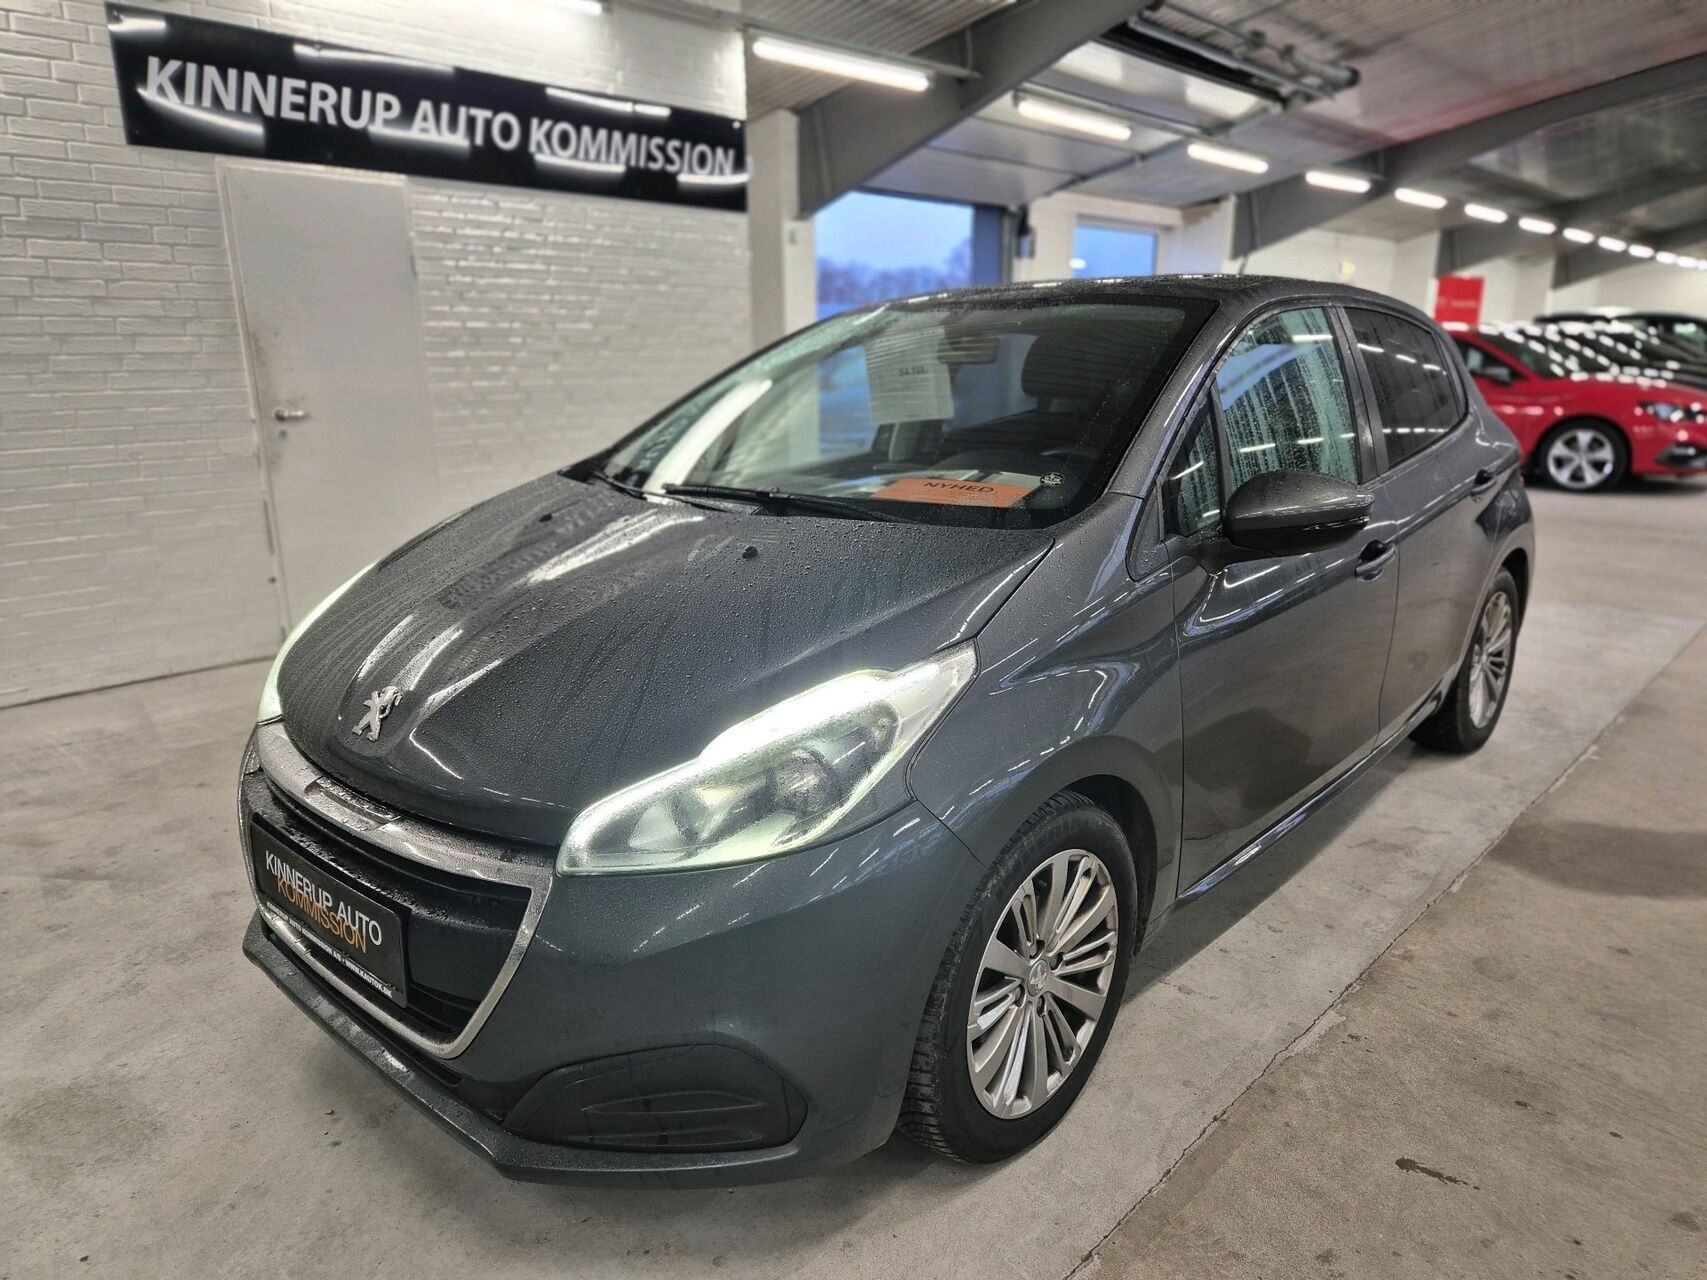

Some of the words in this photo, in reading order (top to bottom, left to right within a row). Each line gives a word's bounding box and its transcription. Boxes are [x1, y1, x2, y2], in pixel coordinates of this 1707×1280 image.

[146, 55, 401, 129] KINNERUP
[411, 99, 521, 150] AUTO
[529, 117, 735, 176] KOMMISSION
[923, 482, 994, 492] NYHED
[265, 850, 333, 908] KINNERUP
[336, 901, 383, 946] AUTO
[276, 877, 368, 954] KOMMISSION
